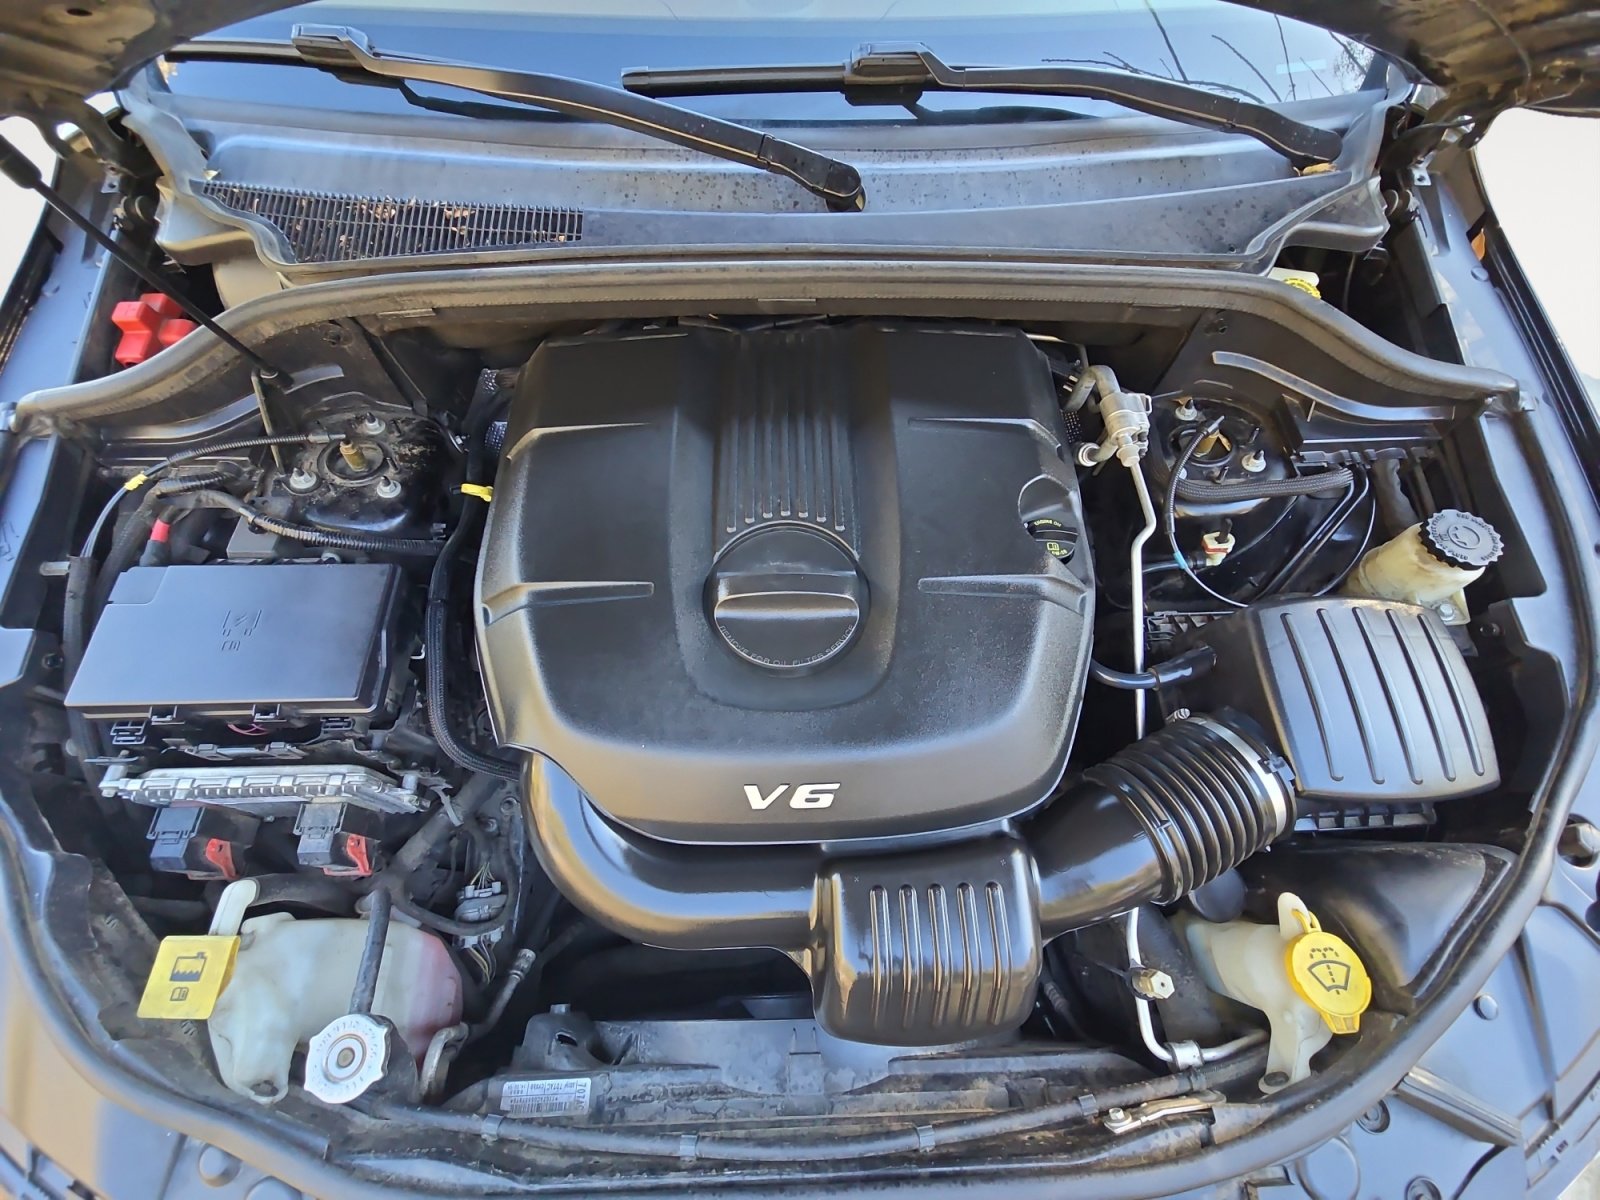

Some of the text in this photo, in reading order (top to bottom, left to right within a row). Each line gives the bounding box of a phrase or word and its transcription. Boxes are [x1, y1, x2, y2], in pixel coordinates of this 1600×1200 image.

[719, 625, 750, 654] REMOVE
[750, 652, 770, 665] FOR
[825, 624, 854, 654] SERVICE
[743, 782, 841, 810] V6
